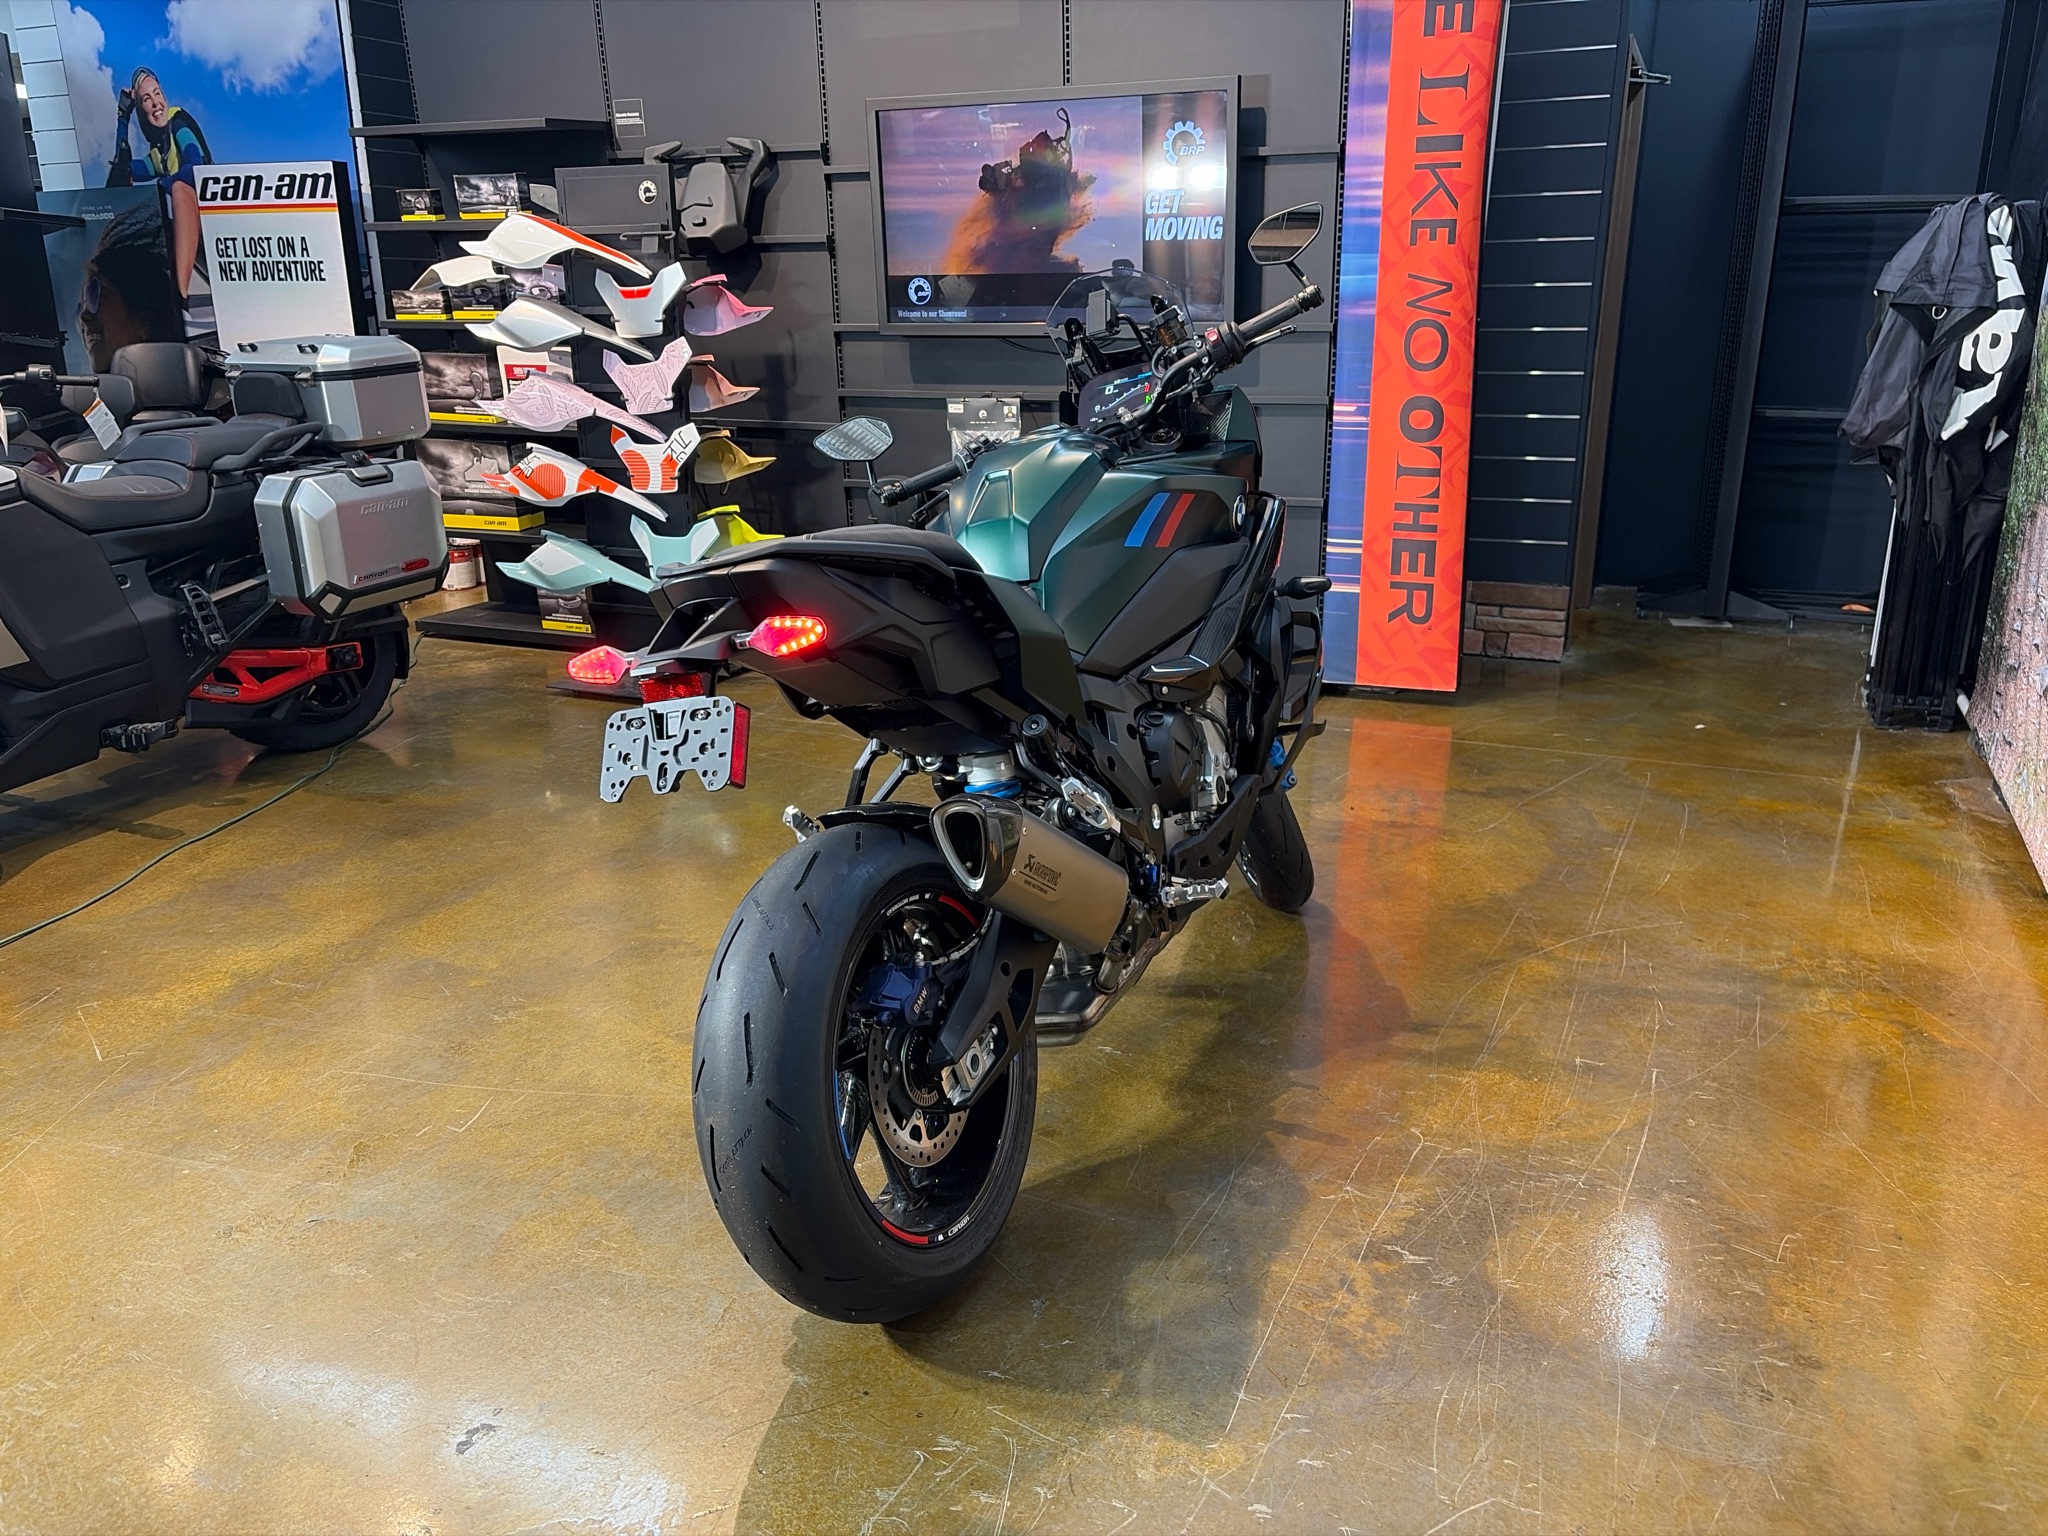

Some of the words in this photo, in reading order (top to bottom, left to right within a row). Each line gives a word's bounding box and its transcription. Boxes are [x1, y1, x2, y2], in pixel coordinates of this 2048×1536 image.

[1180, 145, 1206, 156] BRP
[1409, 63, 1470, 247] LIKE
[198, 172, 333, 202] can-am
[1145, 189, 1185, 214] GET
[1145, 215, 1224, 241] MOVING
[215, 237, 238, 259] GET
[241, 236, 273, 258] LOST
[276, 236, 297, 258] ON
[300, 236, 310, 258] A
[217, 260, 247, 282] NEW
[251, 260, 327, 282] ADVENTURE
[897, 309, 921, 318] Welcome
[922, 309, 928, 318] to
[938, 309, 968, 318] Showroom!
[1403, 272, 1454, 373] NO
[360, 496, 410, 515] can-am
[1387, 395, 1445, 626] OTHER
[358, 570, 388, 582] CANYON
[913, 986, 928, 1014] BMW
